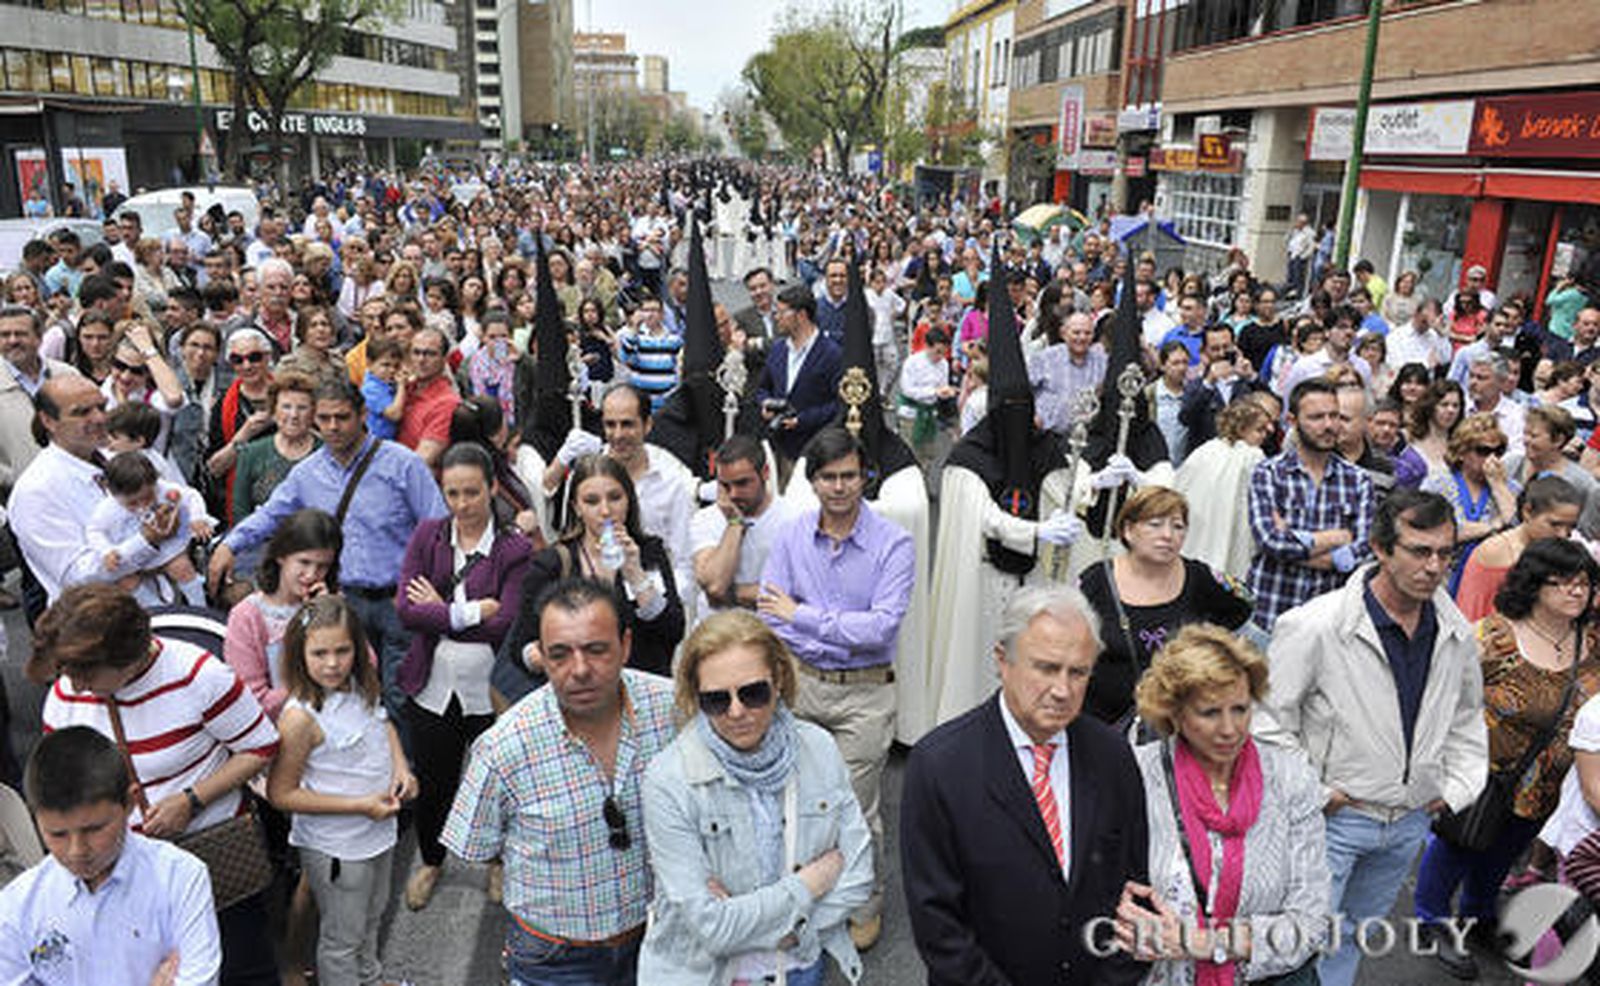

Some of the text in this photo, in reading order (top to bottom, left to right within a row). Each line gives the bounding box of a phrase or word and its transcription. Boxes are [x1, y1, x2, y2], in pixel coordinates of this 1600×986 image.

[216, 111, 235, 130] E
[313, 116, 367, 135] INGLES
[1380, 108, 1419, 130] outlet
